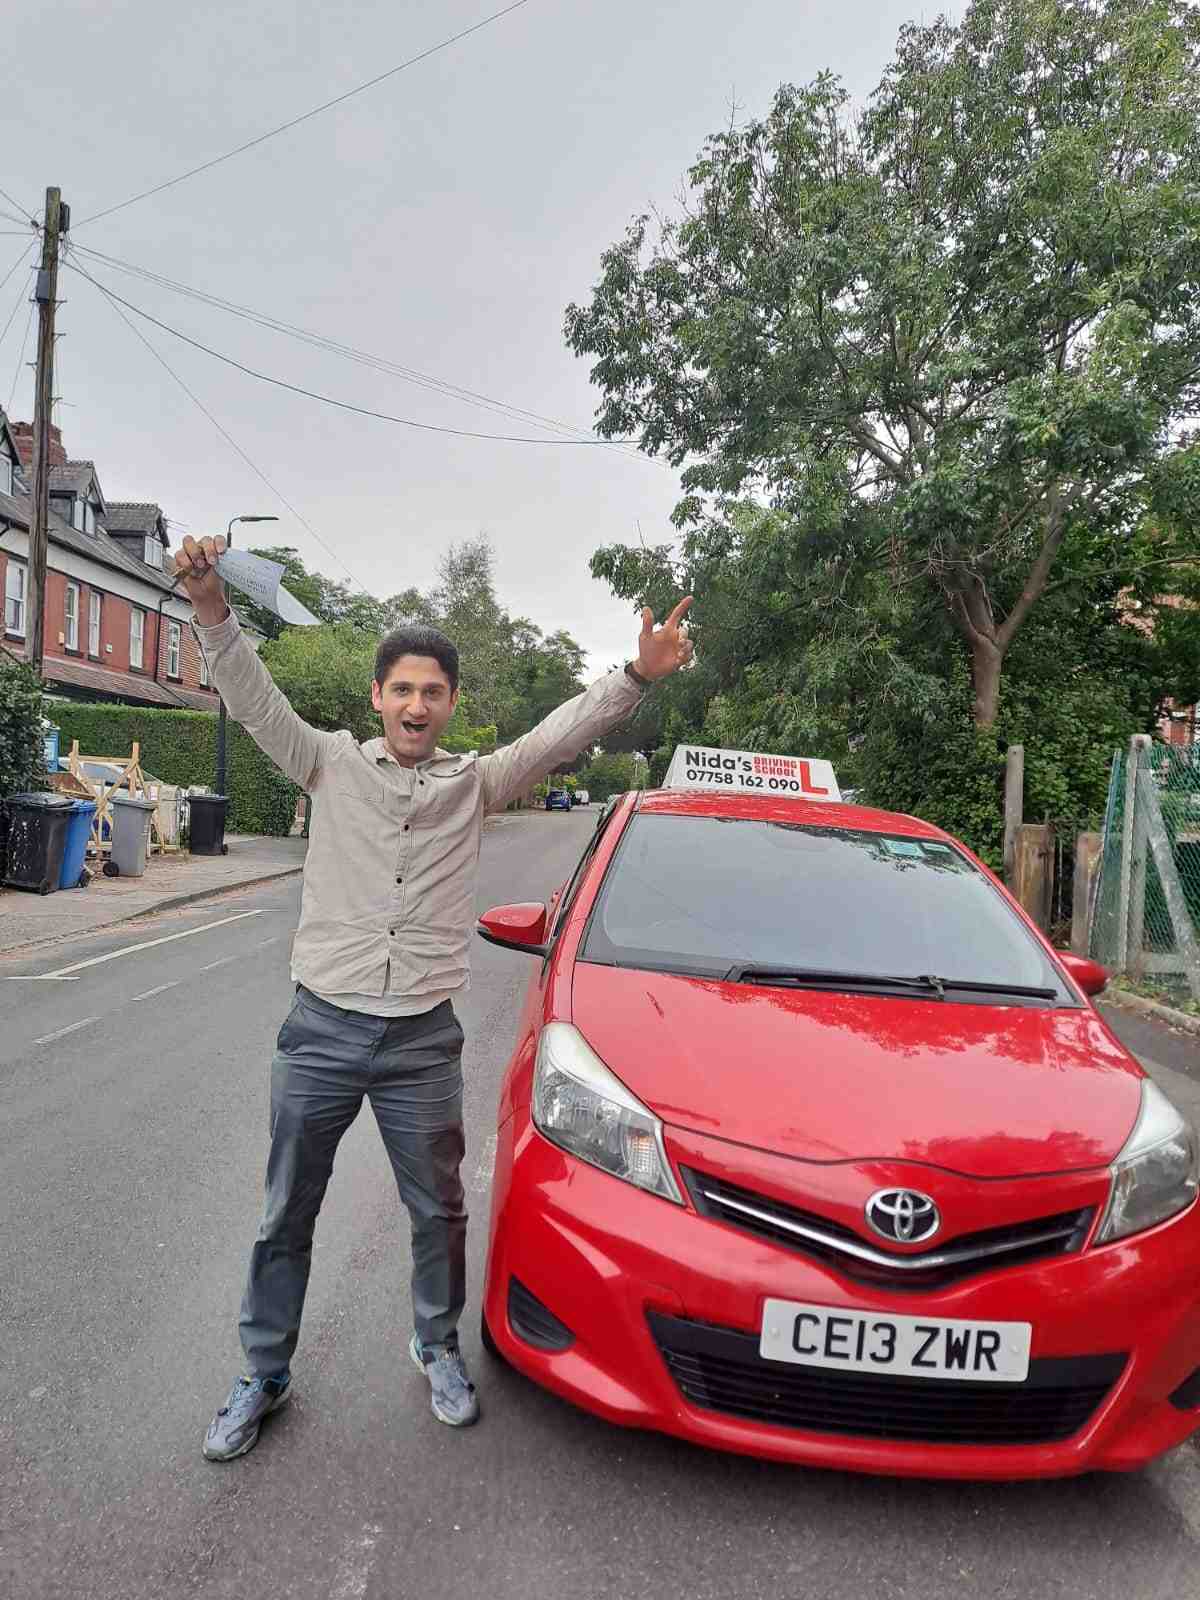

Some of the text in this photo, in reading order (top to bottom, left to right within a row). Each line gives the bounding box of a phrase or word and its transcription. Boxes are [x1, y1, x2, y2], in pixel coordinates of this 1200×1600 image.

[685, 750, 753, 772] Nida's
[753, 756, 798, 769] DRIVING
[754, 766, 796, 777] SCHOOL
[686, 769, 800, 791] 07758 162 090
[799, 761, 829, 795] L
[792, 1312, 1001, 1371] CE13 ZWR
